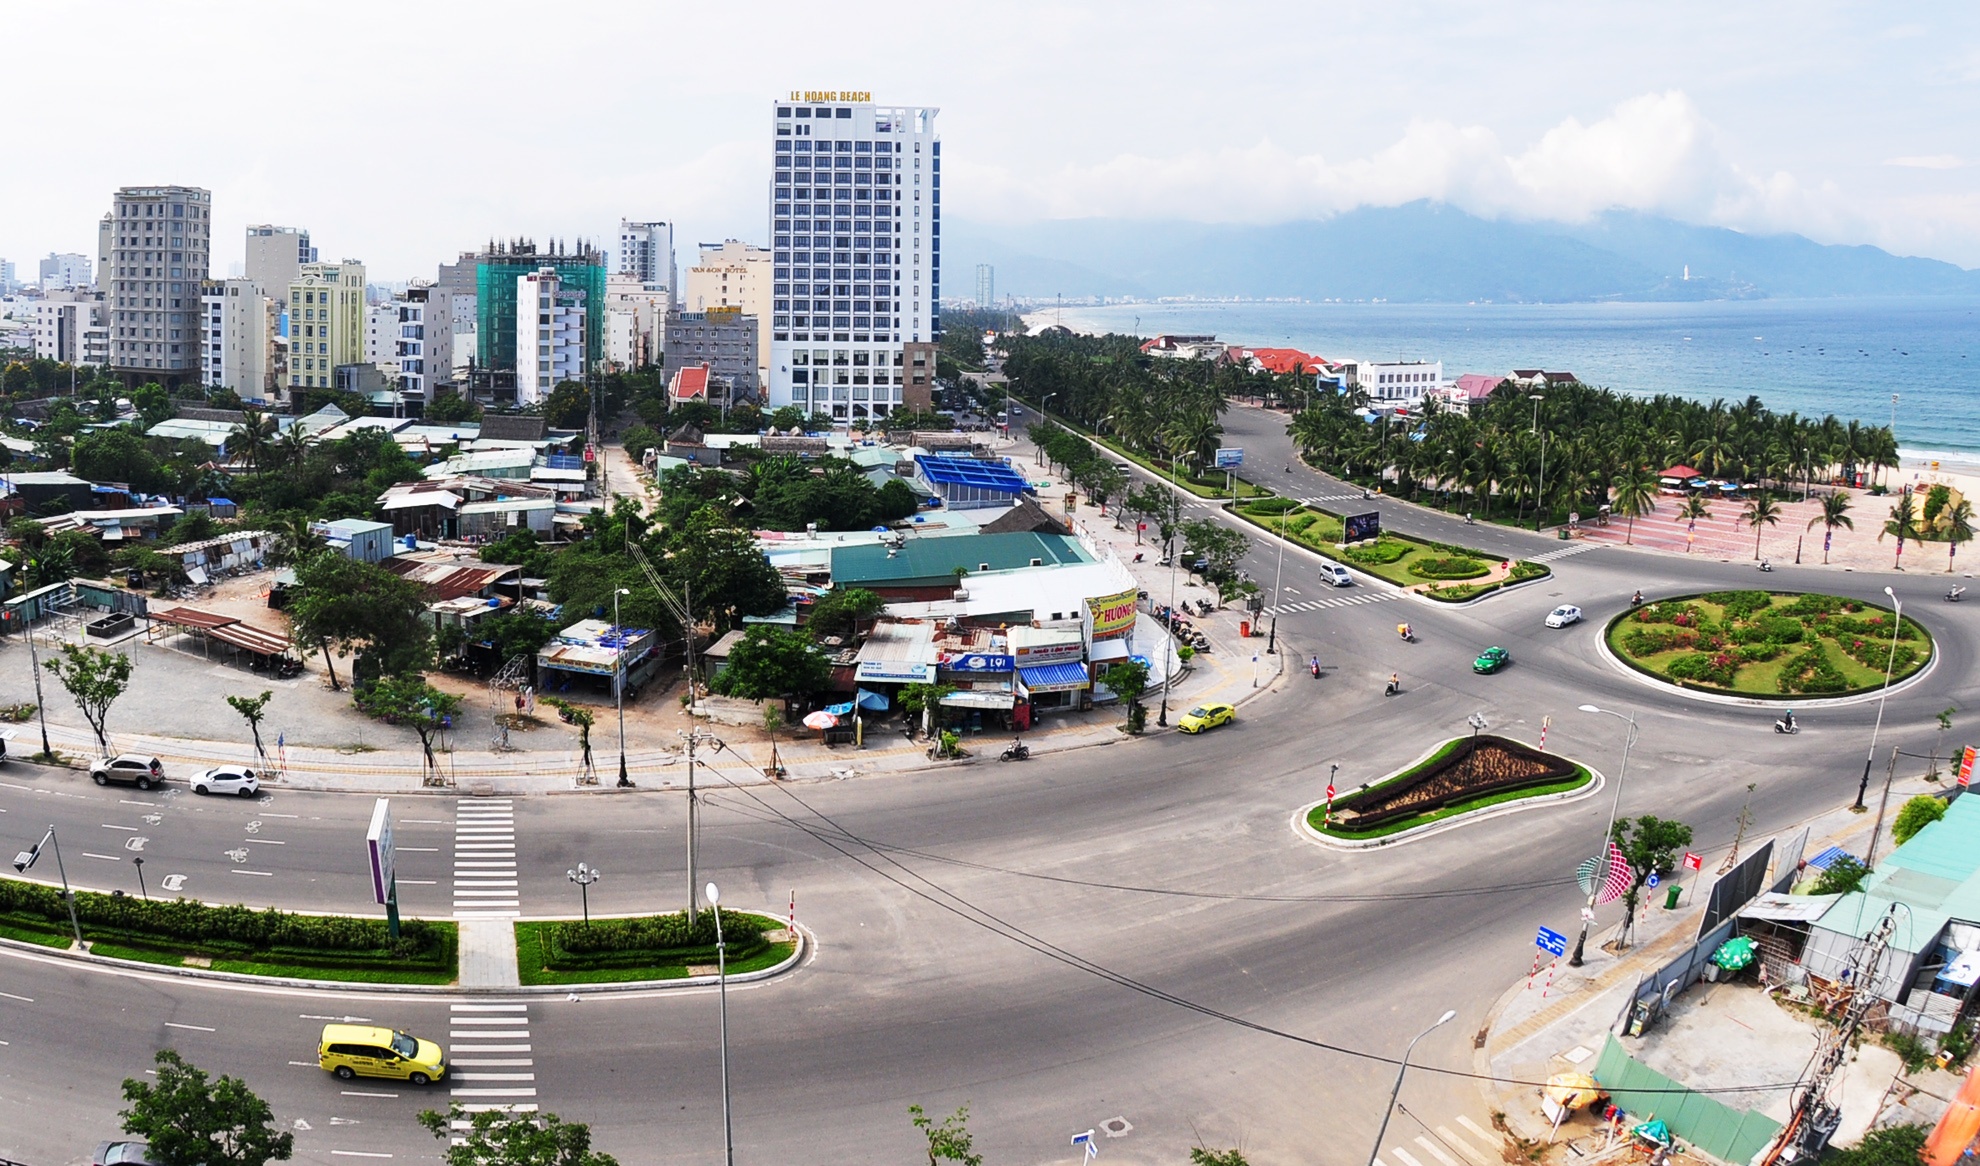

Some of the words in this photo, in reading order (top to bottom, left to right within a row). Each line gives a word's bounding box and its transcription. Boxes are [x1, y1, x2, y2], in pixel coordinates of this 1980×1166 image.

[790, 91, 800, 101] LE
[804, 91, 837, 102] HOANG
[840, 91, 871, 102] BEACH
